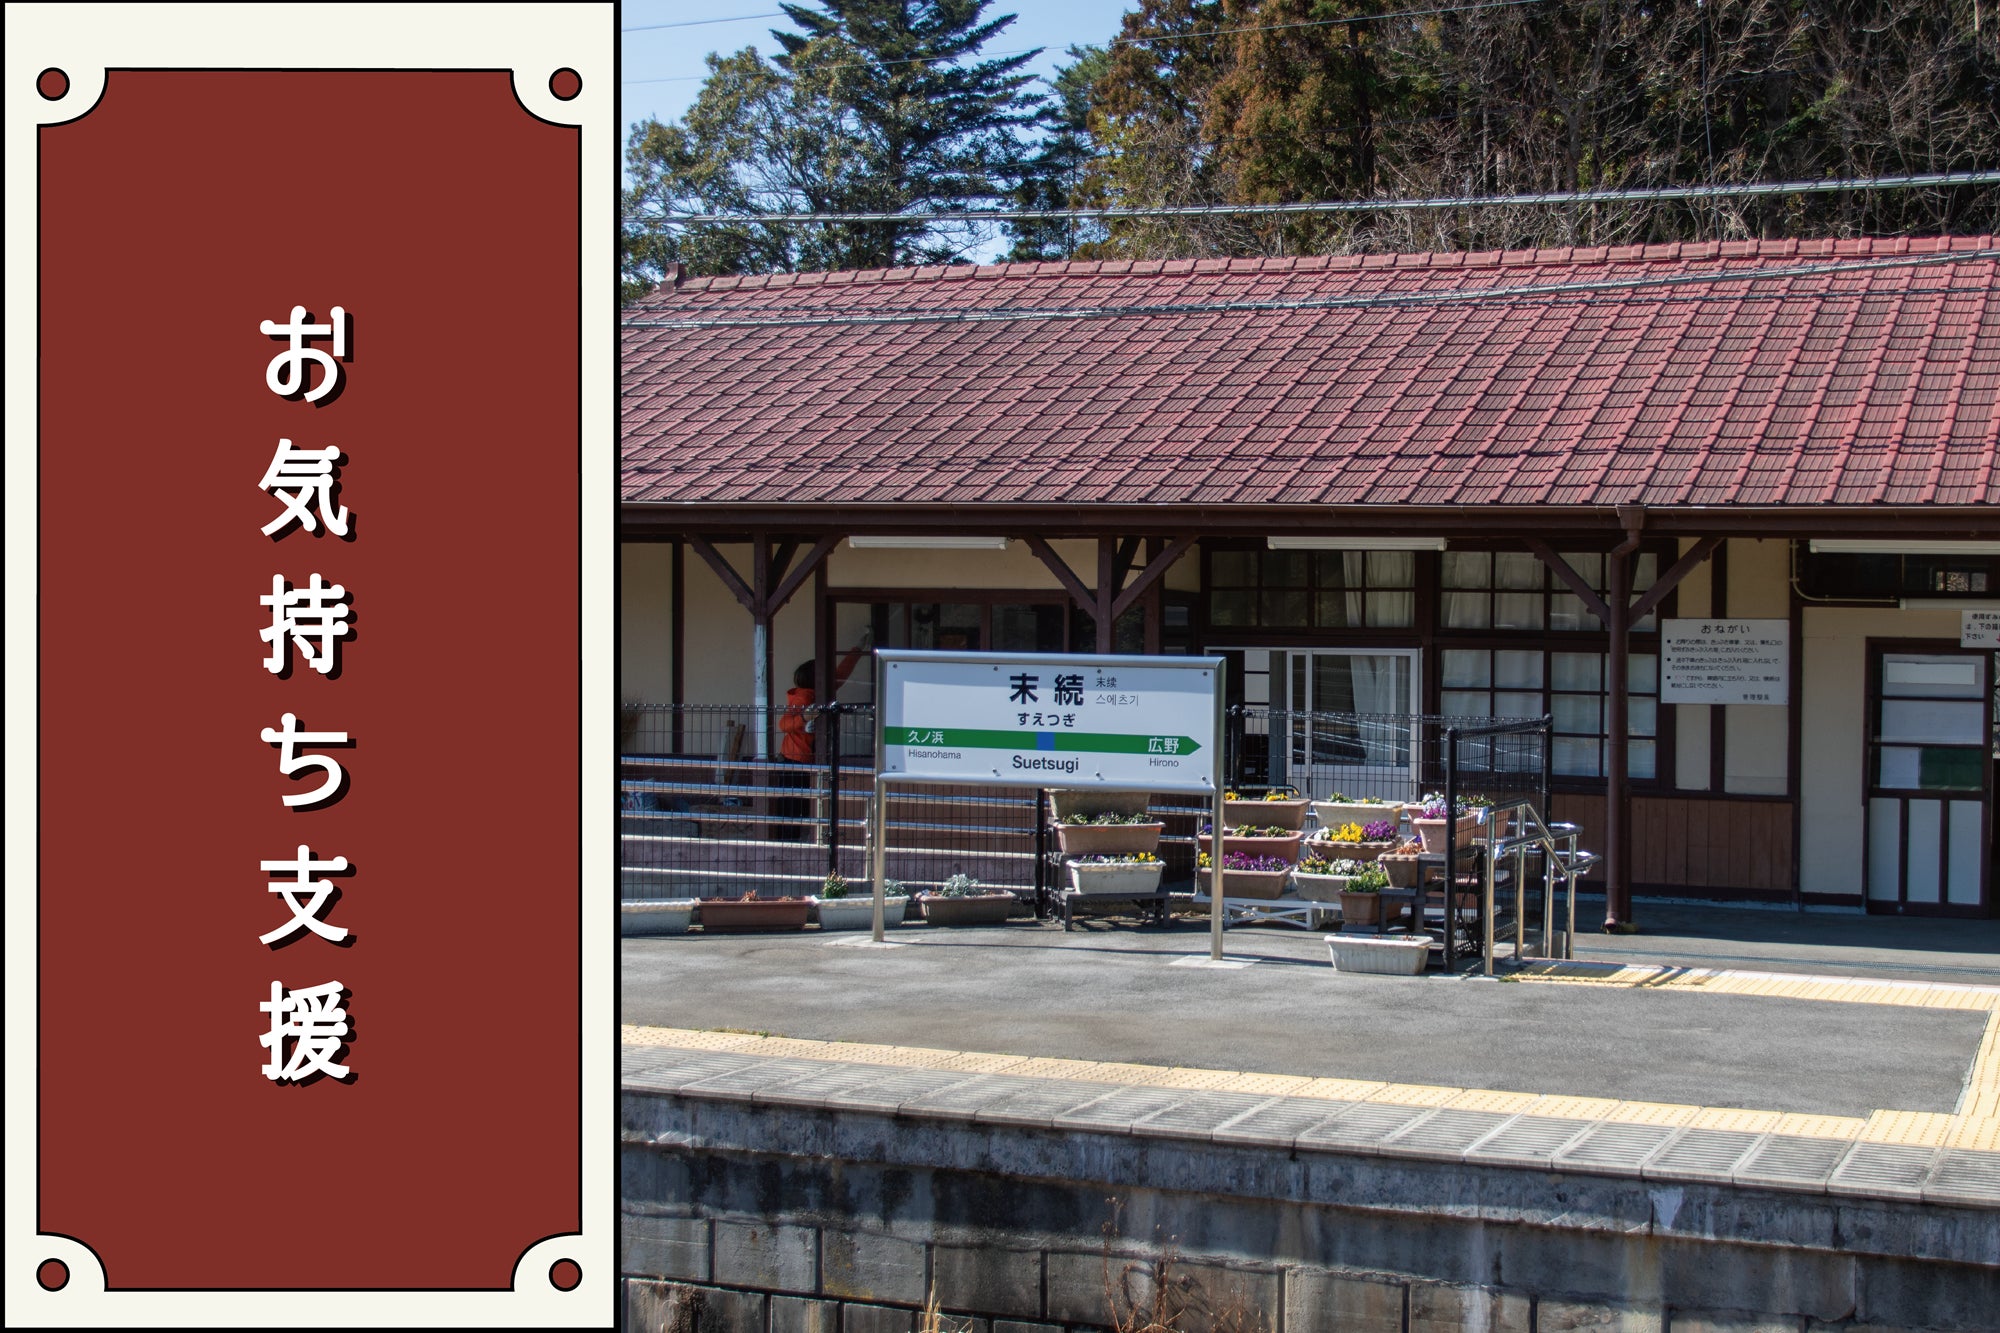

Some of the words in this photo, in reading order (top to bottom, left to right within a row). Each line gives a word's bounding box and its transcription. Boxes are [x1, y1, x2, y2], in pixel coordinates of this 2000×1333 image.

[1701, 624, 1750, 634] おねがい
[1009, 673, 1084, 706] 末続
[1096, 676, 1117, 689] 末续
[1096, 693, 1139, 707] 스에츠기
[1018, 712, 1076, 727] すえつぎ
[908, 730, 944, 744] 久ノ浜
[1148, 737, 1179, 754] 広野
[908, 749, 962, 760] Hisanohama
[1012, 754, 1079, 773] Suetsugi
[1149, 757, 1180, 767] Hirono
